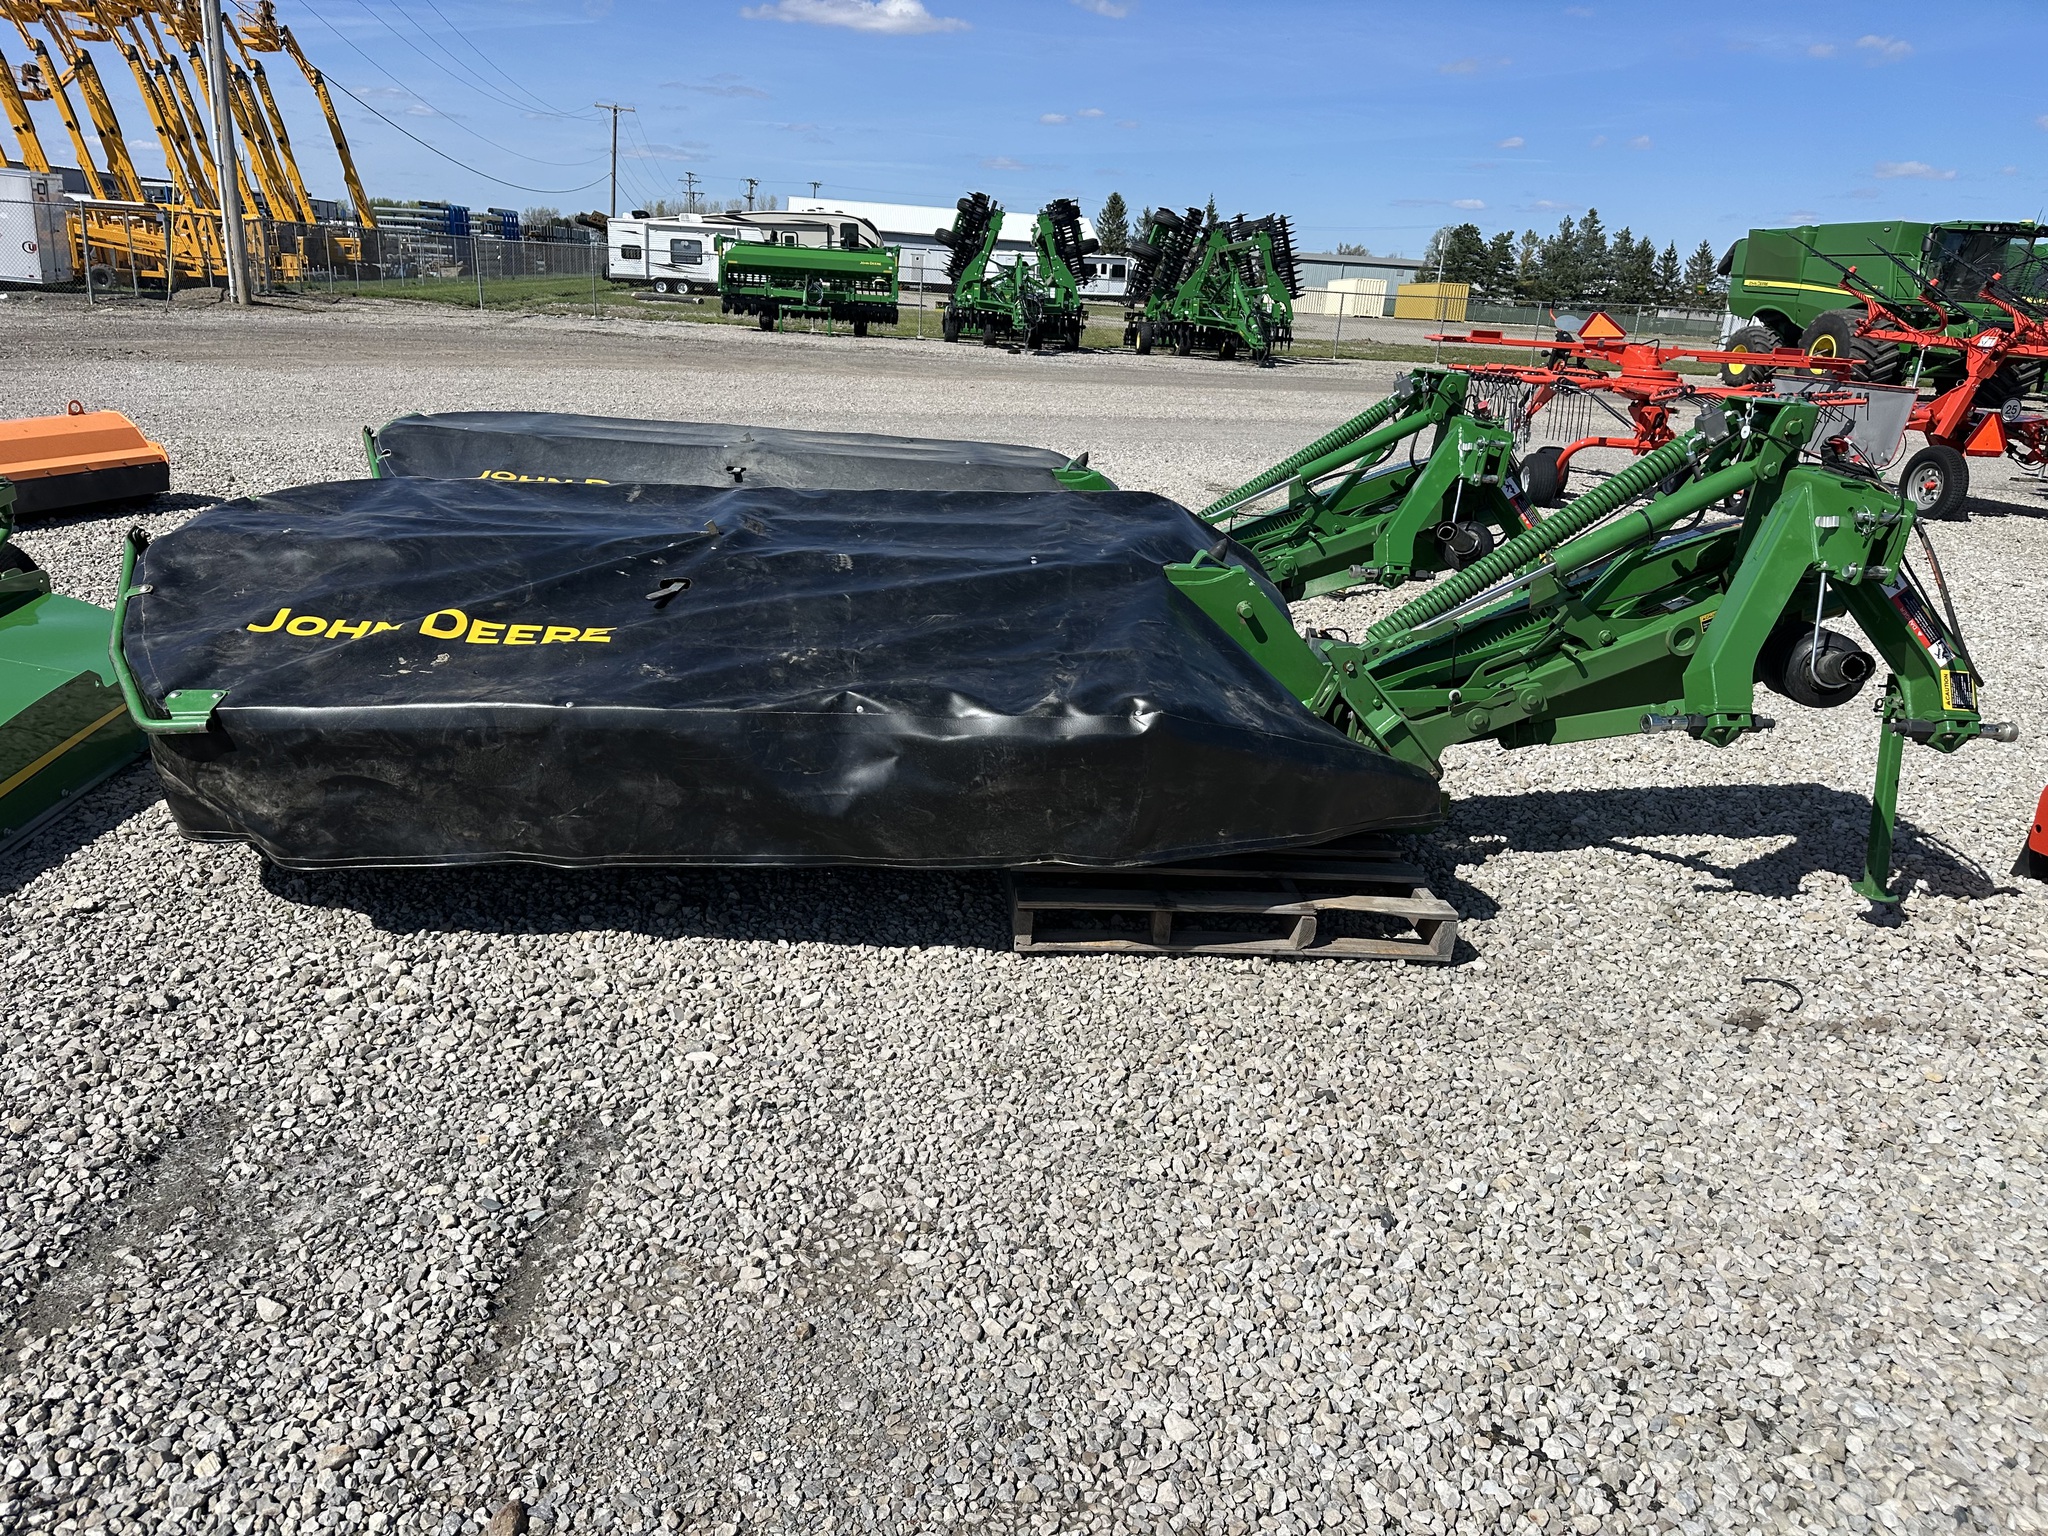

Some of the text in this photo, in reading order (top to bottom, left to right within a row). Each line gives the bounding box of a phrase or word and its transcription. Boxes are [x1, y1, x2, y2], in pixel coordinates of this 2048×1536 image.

[2005, 405, 2018, 414] 25
[246, 608, 618, 645] JOHN DEERE
[1900, 606, 1918, 630] DANGER
